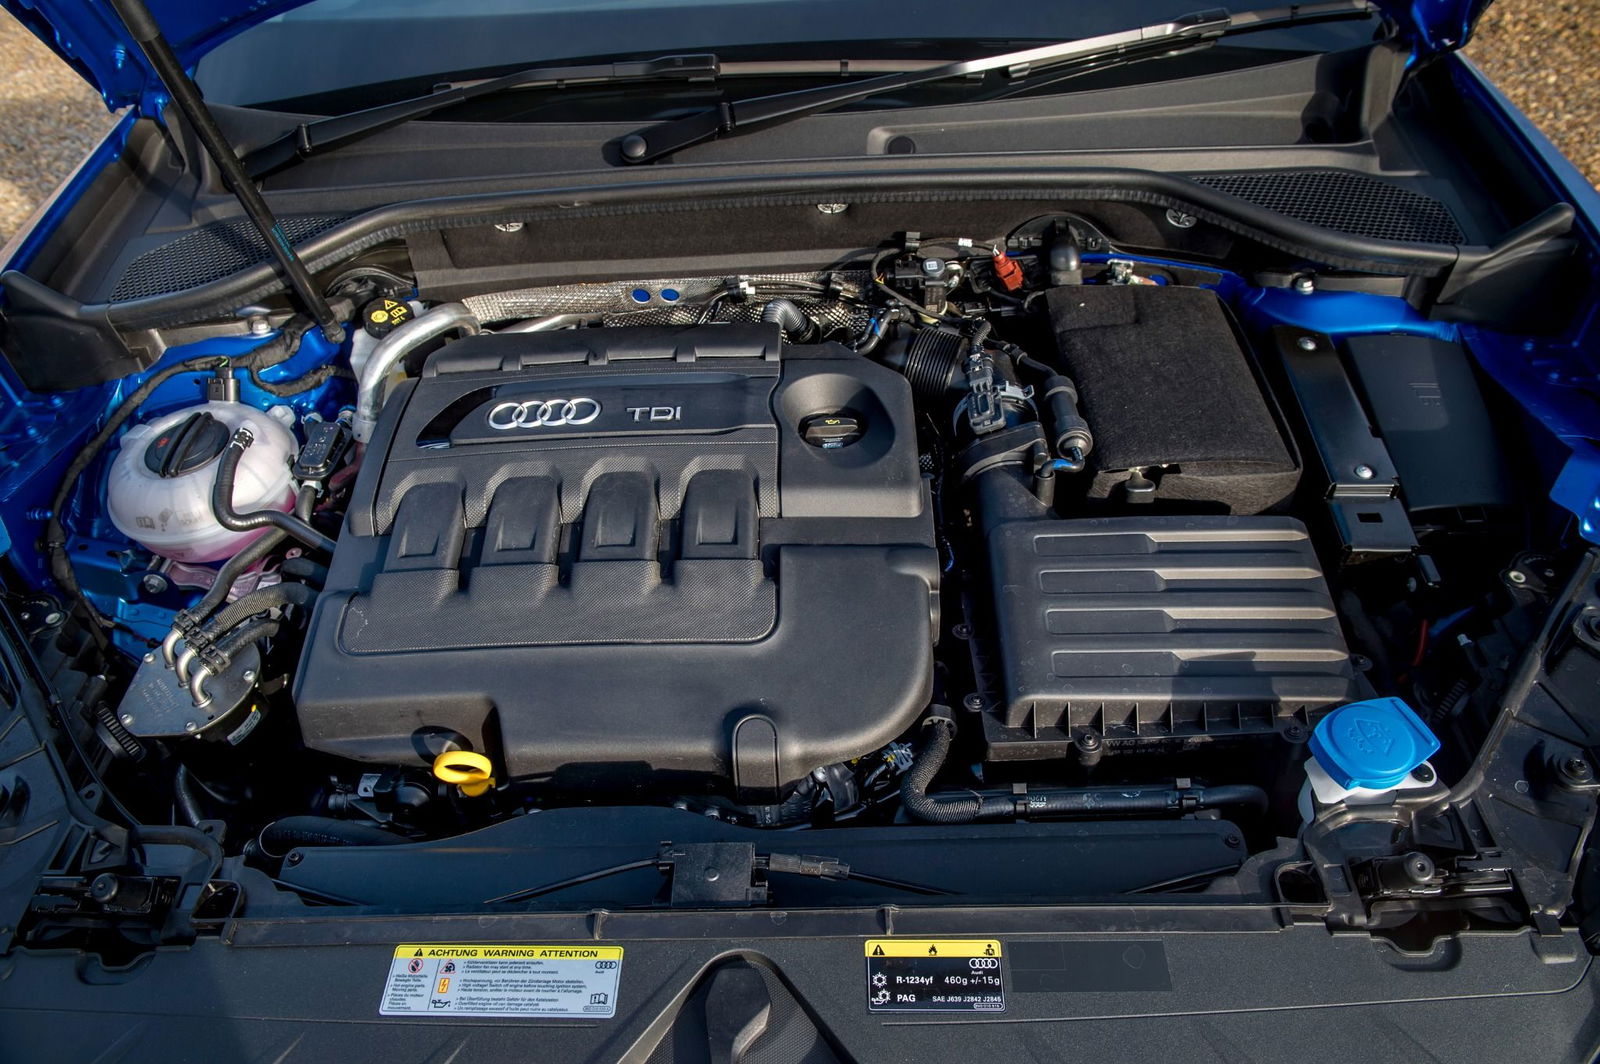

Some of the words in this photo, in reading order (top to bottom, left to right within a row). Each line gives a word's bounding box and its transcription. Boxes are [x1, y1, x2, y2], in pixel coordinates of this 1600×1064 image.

[626, 406, 682, 421] TDI
[428, 949, 477, 957] ACHTUNG
[483, 949, 535, 957] WARNING
[896, 976, 934, 985] R-1234yf
[944, 976, 968, 985] 460g
[897, 994, 916, 1002] PAG
